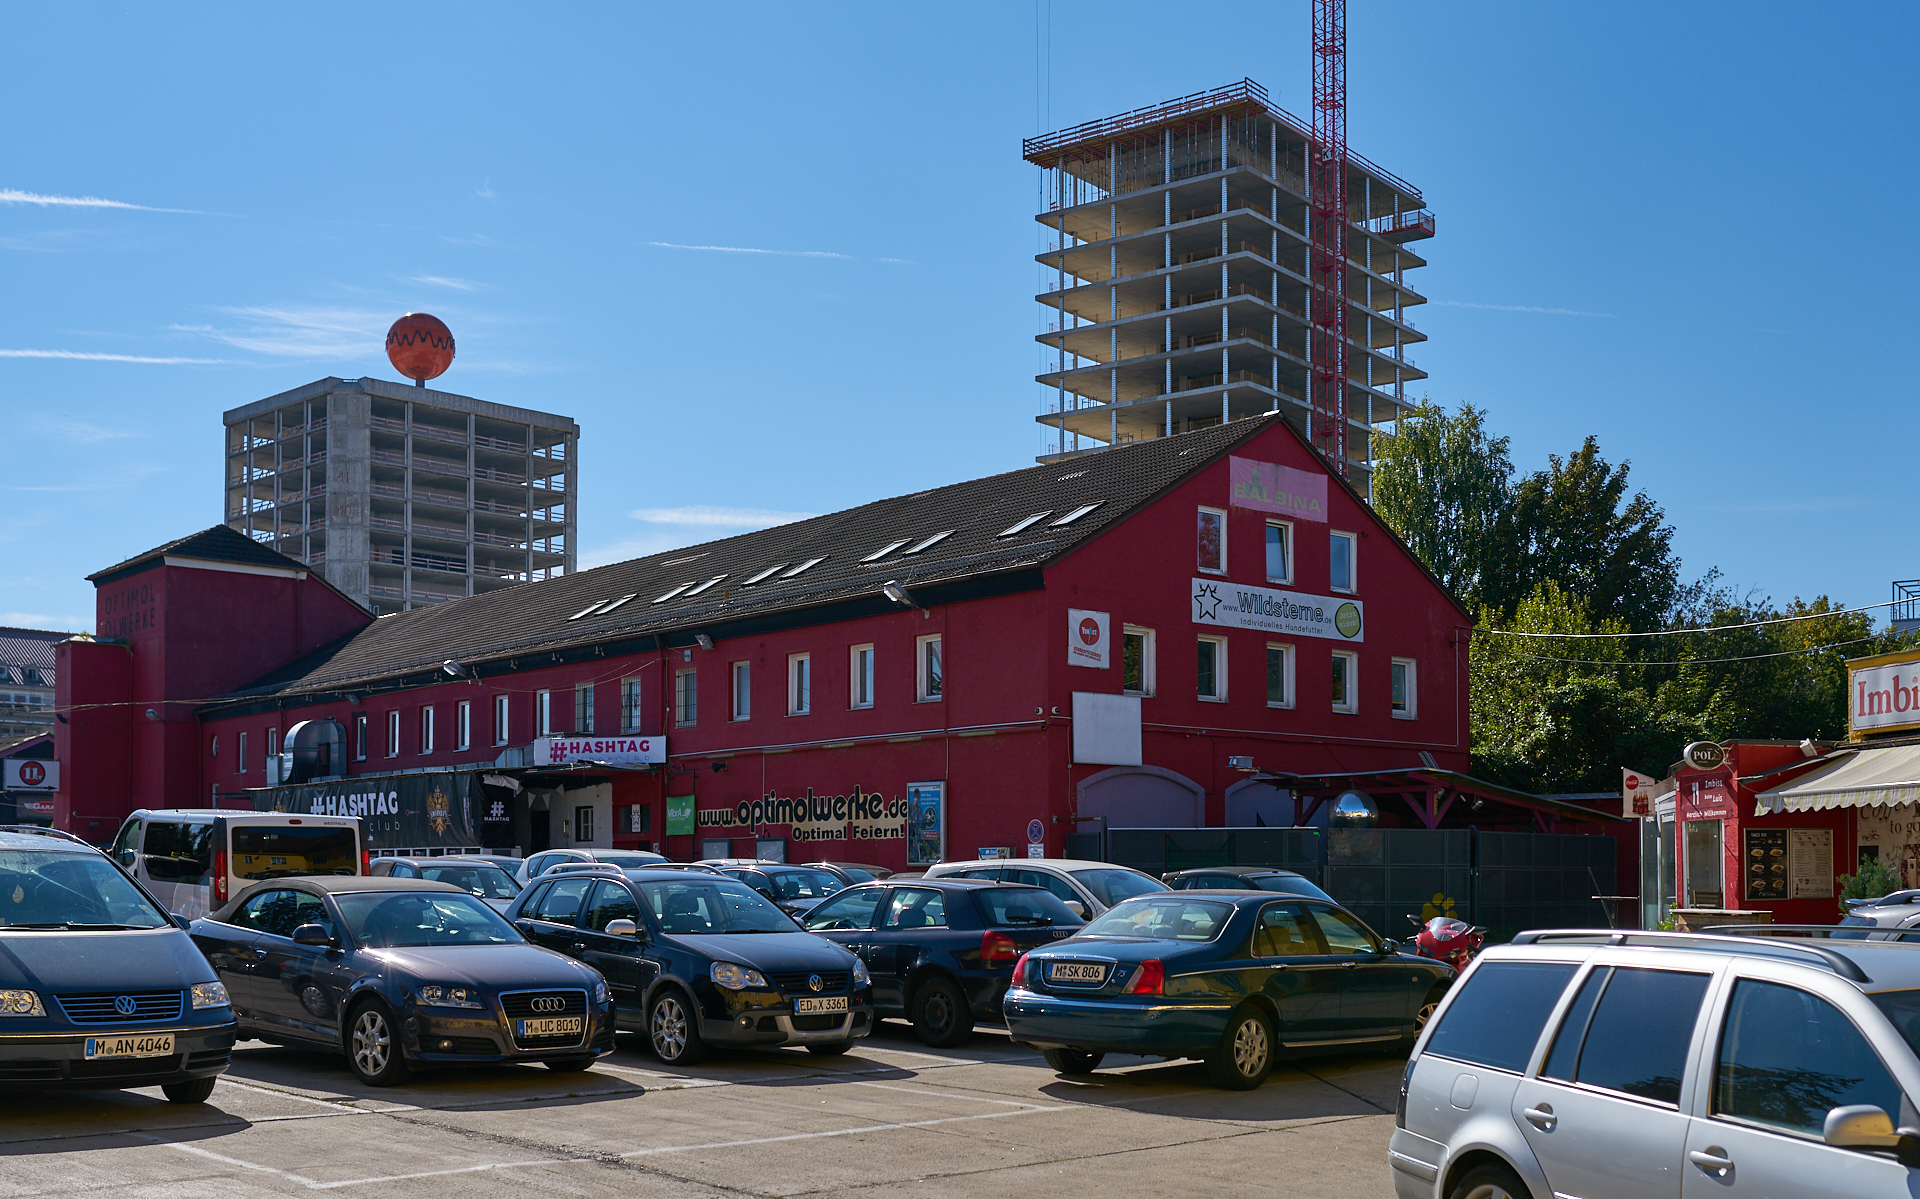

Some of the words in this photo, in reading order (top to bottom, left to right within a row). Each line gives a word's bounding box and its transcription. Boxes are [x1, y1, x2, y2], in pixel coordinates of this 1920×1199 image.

[1234, 482, 1321, 513] BALBINA
[338, 504, 351, 517] 10
[105, 582, 154, 615] OPTIMOL
[1339, 610, 1357, 619] Jetzt
[1240, 617, 1283, 630] Individuelles
[1285, 623, 1323, 635] Hundefutter
[1858, 674, 1919, 717] Imbi
[1705, 779, 1723, 788] Imbiss
[698, 785, 908, 834] www.optimolwerke.de
[793, 826, 847, 842] Optimal
[853, 824, 905, 839] Feiern!
[1890, 820, 1901, 833] to
[1906, 820, 1920, 838] go
[1055, 965, 1063, 976] M
[1068, 965, 1081, 978] SK
[1082, 966, 1100, 978] 806
[800, 1000, 812, 1011] ED
[818, 1000, 824, 1010] X
[826, 998, 846, 1010] 3361
[526, 1021, 533, 1033] M
[540, 1020, 554, 1032] UC
[556, 1019, 580, 1031] 8019
[95, 1040, 106, 1054] M
[115, 1039, 134, 1053] AN
[137, 1037, 170, 1052] 4046
